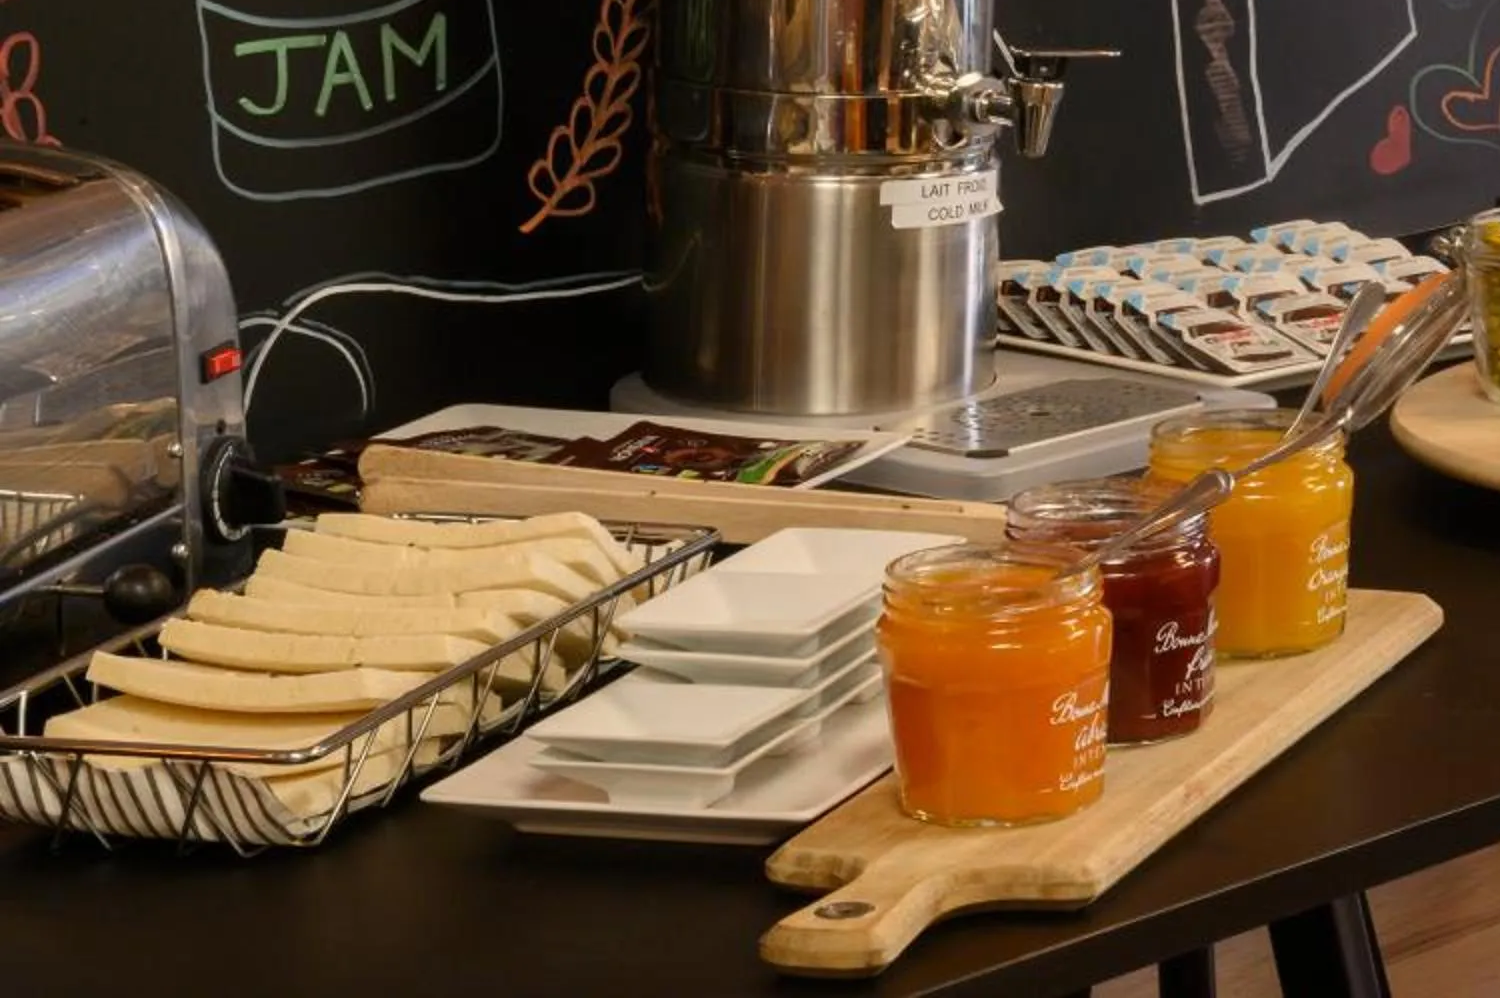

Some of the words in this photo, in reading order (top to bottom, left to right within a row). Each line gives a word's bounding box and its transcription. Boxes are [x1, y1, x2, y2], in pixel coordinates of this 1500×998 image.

[234, 11, 448, 118] JAM
[920, 183, 951, 199] LAIT
[927, 205, 965, 221] COLD
